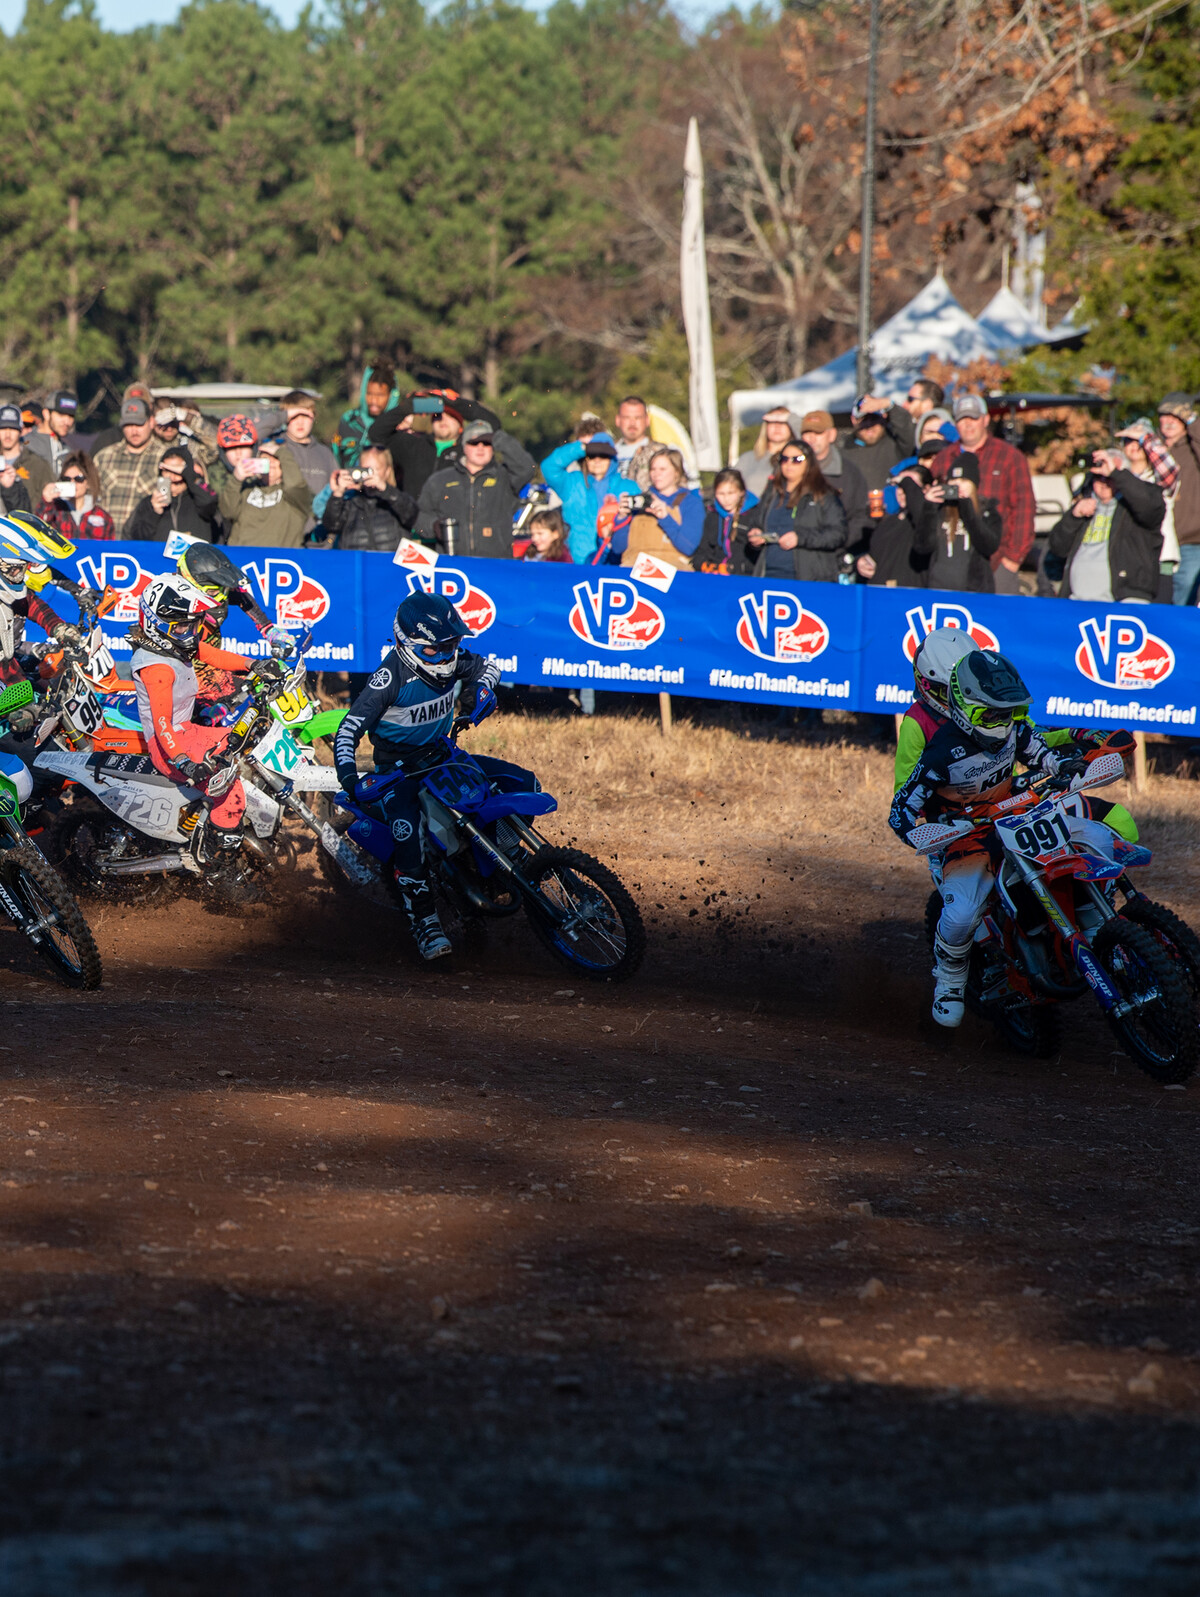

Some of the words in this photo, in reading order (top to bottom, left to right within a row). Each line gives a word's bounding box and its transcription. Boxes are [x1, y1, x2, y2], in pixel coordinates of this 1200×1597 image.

[241, 558, 303, 622] VP
[573, 577, 637, 643] VP
[738, 589, 801, 655] VP
[541, 656, 685, 685] #MoreThanRaceFuel
[1078, 614, 1147, 682] VP
[708, 667, 851, 699] #MoreThanRaceFuel
[409, 699, 456, 724] YAMAH
[1046, 696, 1197, 725] #MoreThanRaceFuel
[261, 728, 303, 774] 726
[336, 714, 366, 766] YAMAHA
[115, 789, 173, 828] 726
[1014, 812, 1071, 859] 991
[1081, 954, 1114, 998] DUNLOP
